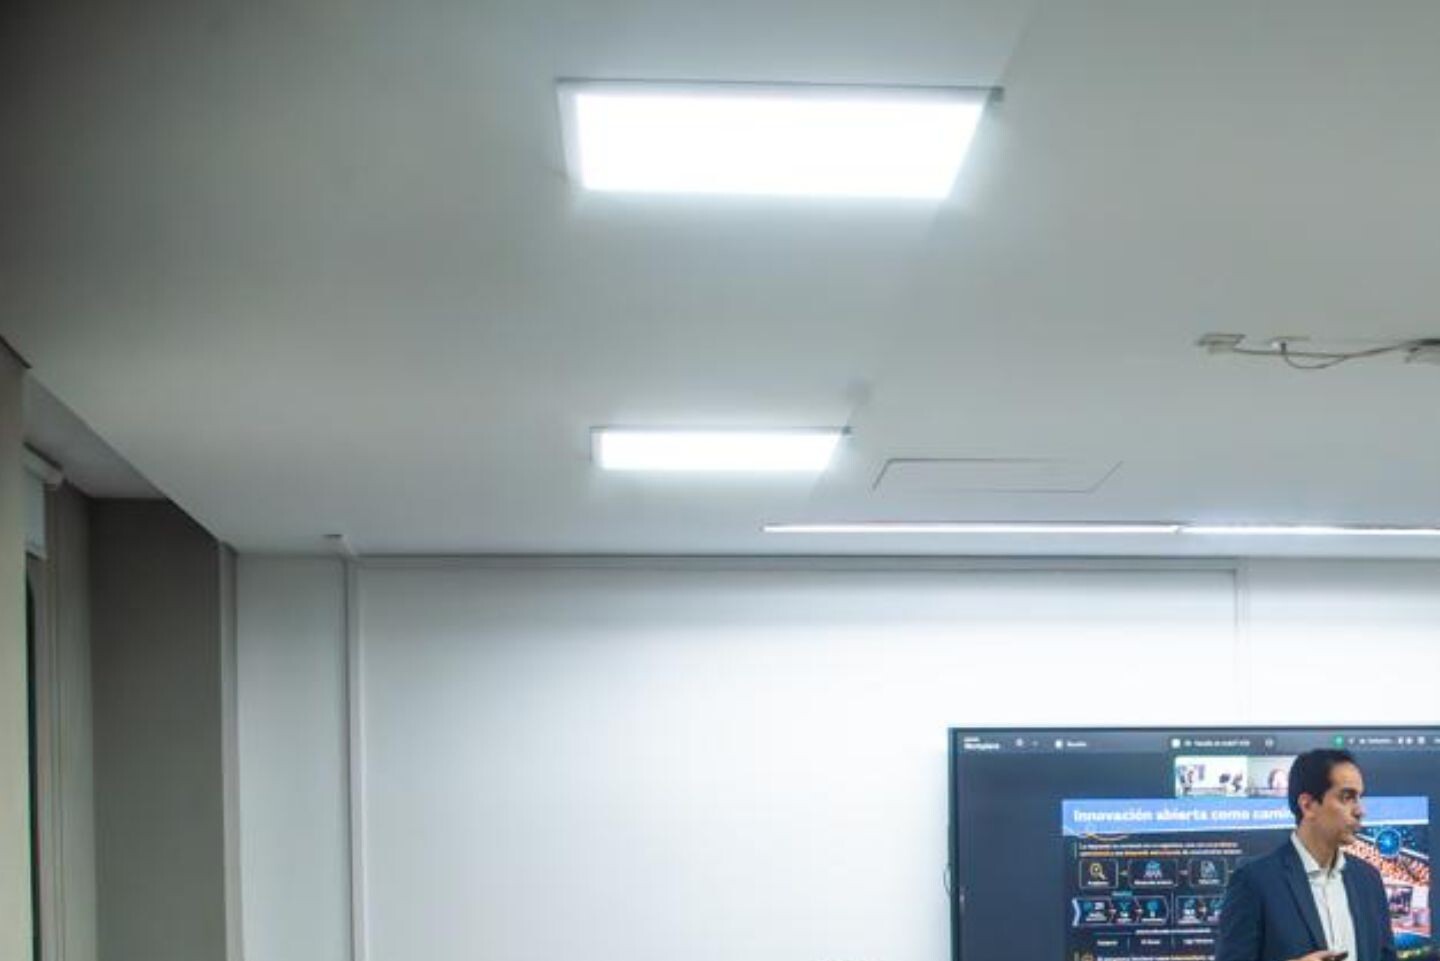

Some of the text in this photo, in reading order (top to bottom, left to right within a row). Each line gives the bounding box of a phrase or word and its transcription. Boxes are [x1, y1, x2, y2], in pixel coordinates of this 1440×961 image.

[1073, 808, 1152, 823] Innovación
[1156, 807, 1207, 822] abierta
[1211, 809, 1250, 821] como
